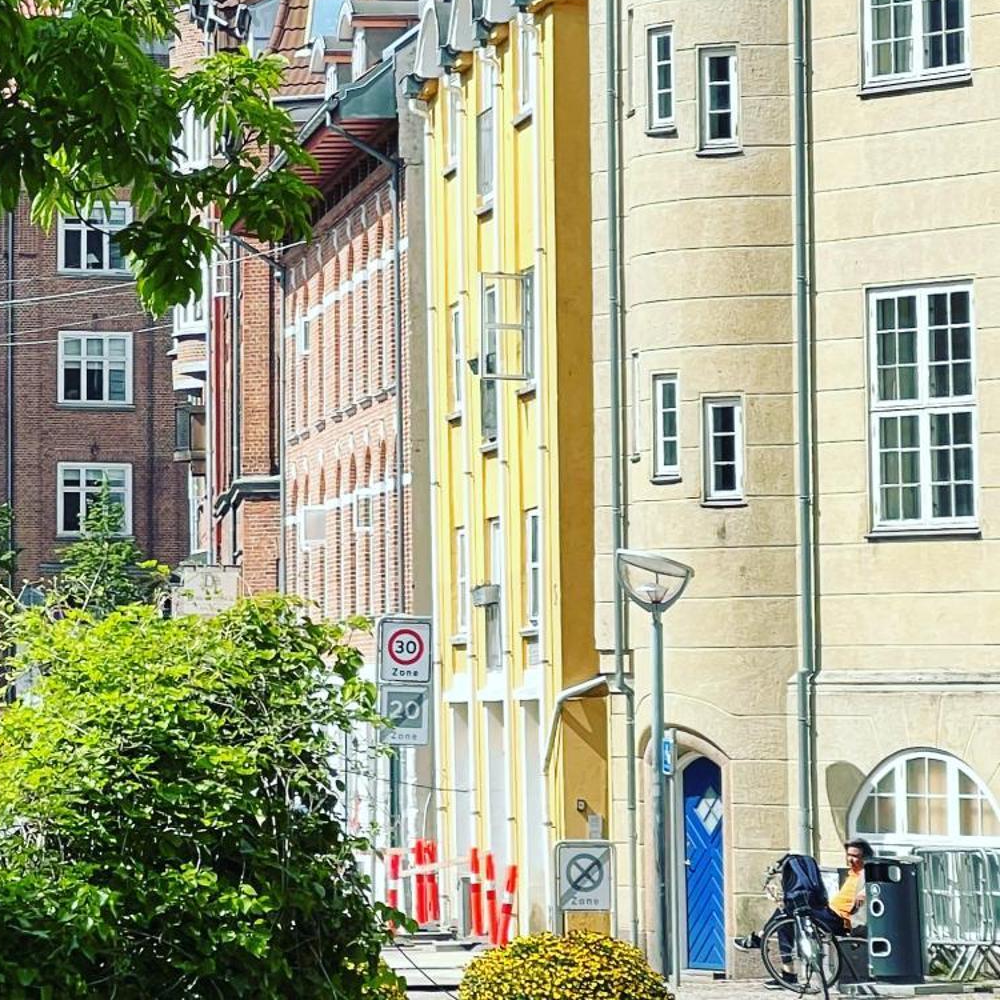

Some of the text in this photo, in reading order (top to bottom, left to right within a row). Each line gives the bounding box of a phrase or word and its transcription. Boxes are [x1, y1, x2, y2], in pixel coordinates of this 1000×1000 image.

[395, 640, 417, 654] 30
[392, 667, 418, 677] Zone
[390, 700, 420, 719] 20
[391, 730, 417, 740] Zone
[571, 896, 599, 905] Zone
